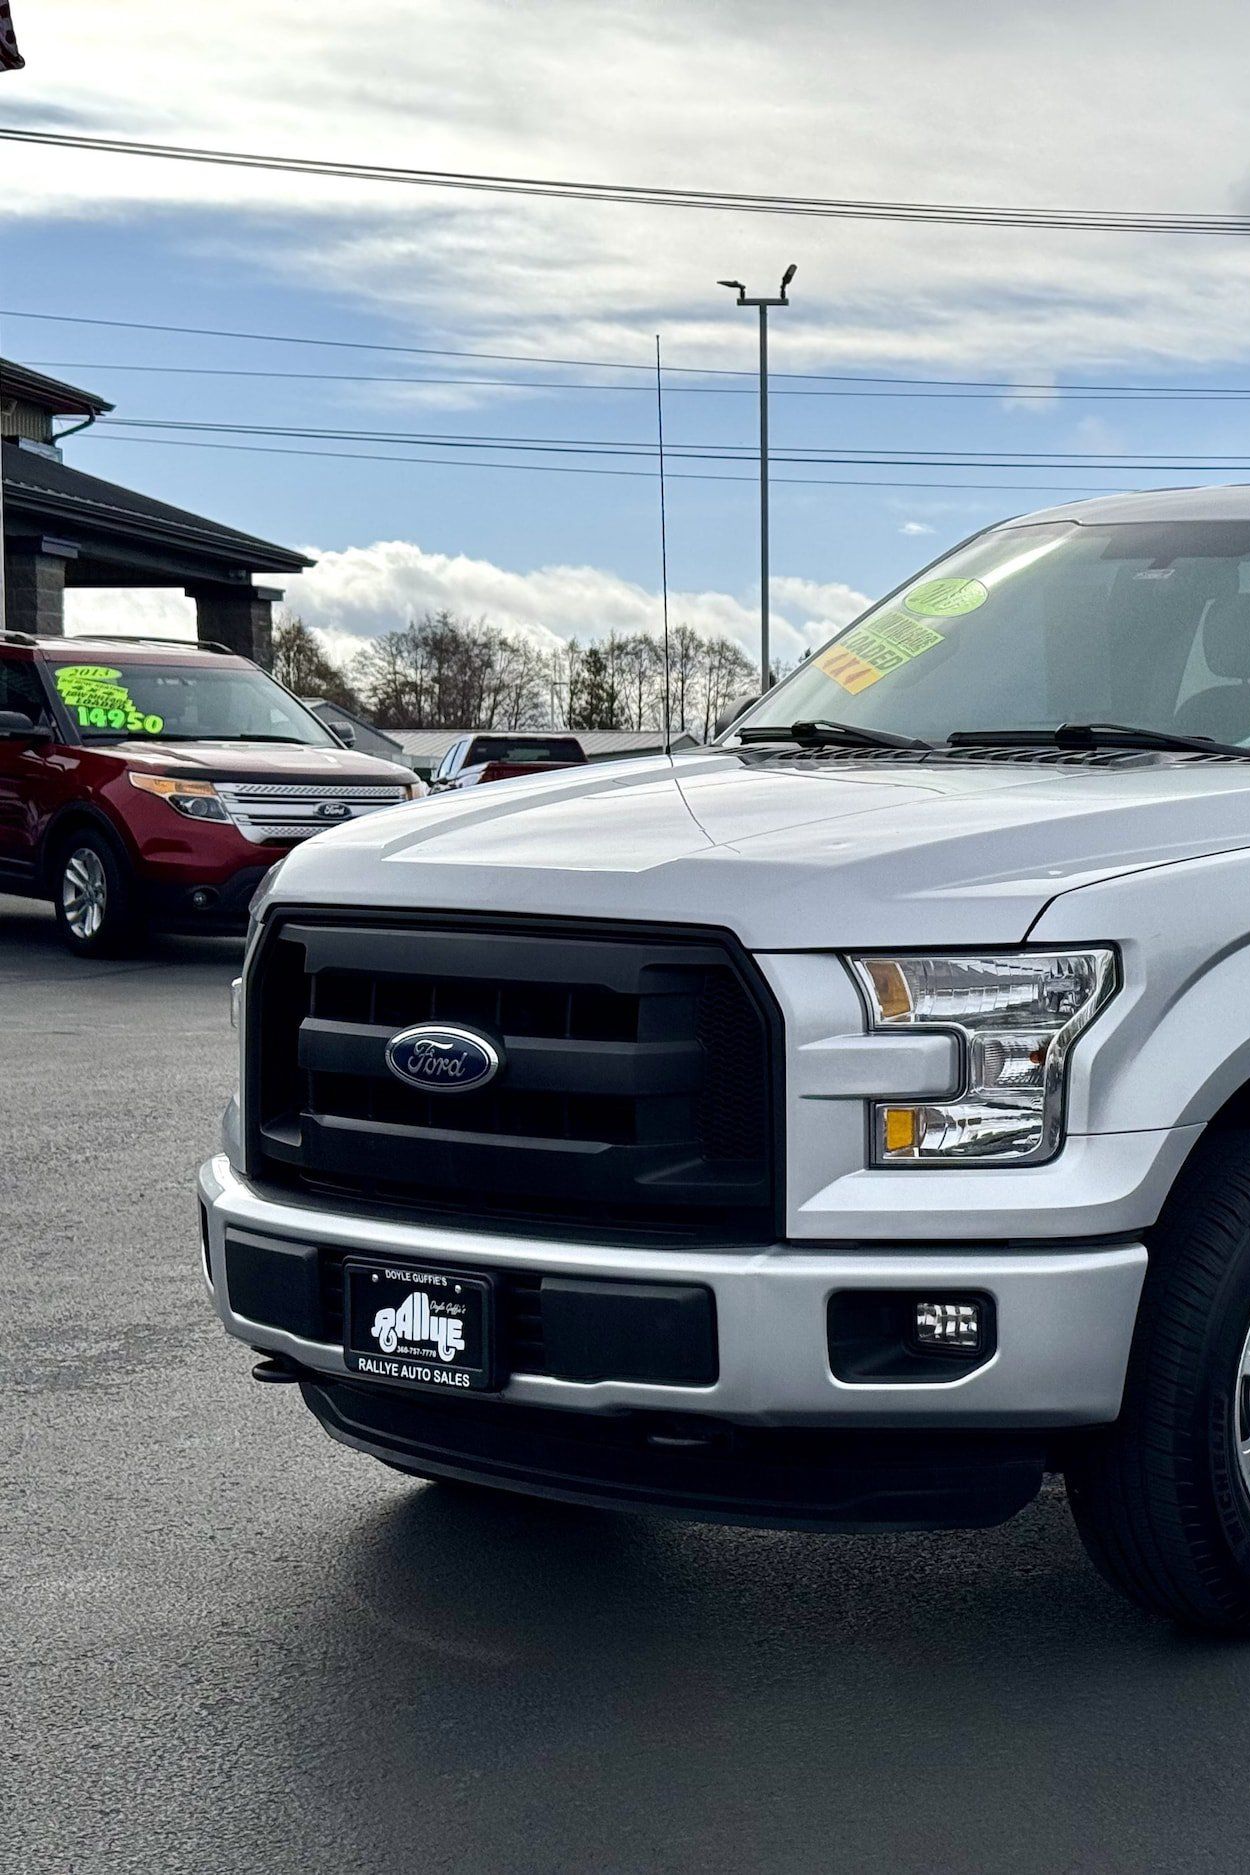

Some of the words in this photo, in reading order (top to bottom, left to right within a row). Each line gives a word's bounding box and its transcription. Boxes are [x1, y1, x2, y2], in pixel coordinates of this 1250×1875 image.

[841, 631, 903, 671] LOADED
[78, 706, 164, 734] 14950
[324, 804, 345, 815] Ford
[407, 1040, 468, 1077] Ford
[385, 1269, 412, 1282] DOYLE
[412, 1273, 447, 1286] GUFFIE'S
[358, 1358, 399, 1376] RALLYE
[400, 1365, 431, 1381] AUTO
[433, 1370, 470, 1387] SALES
